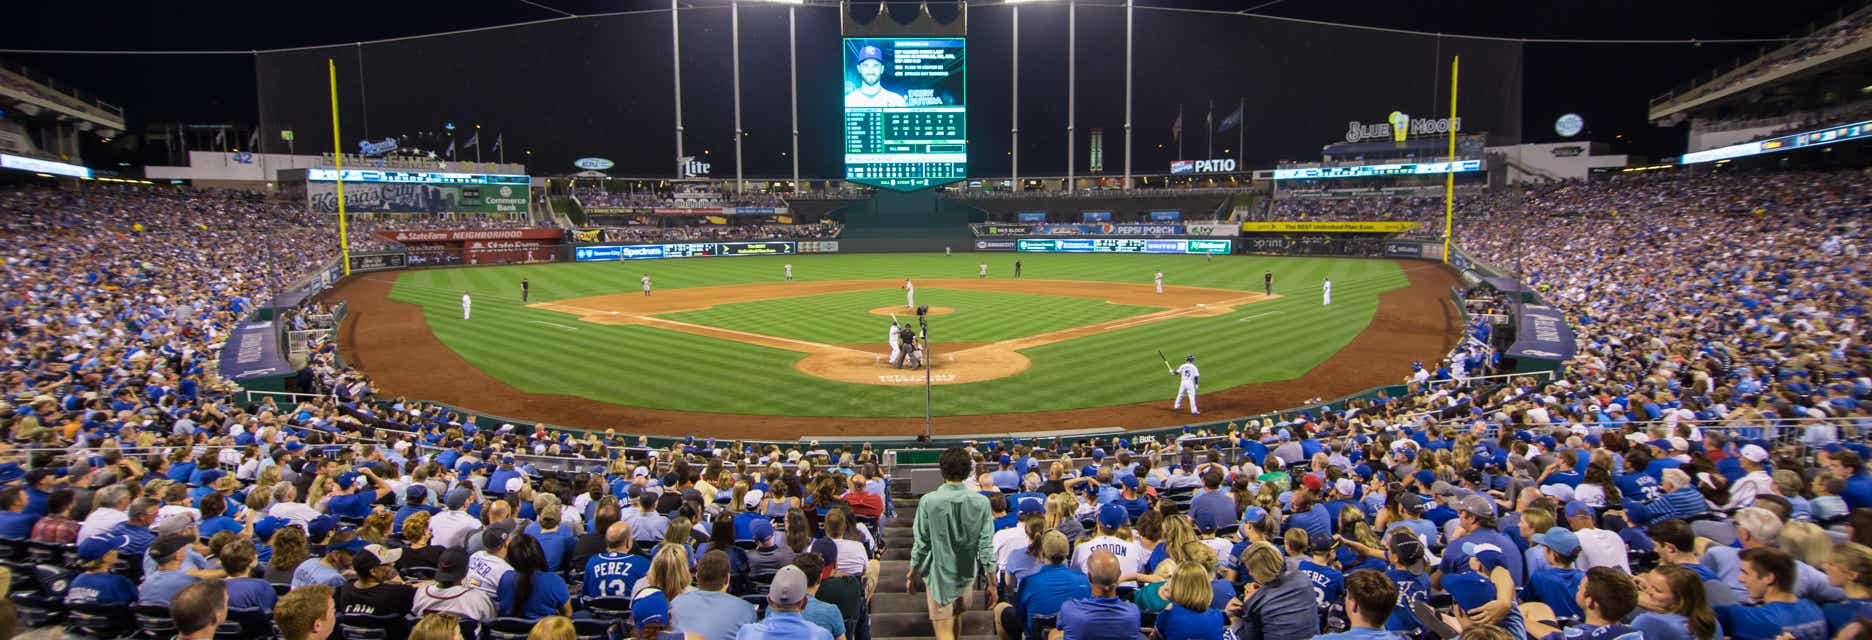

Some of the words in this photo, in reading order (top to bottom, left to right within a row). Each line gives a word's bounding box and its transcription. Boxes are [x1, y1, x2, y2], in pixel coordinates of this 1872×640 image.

[233, 152, 252, 164] 42
[684, 157, 710, 176] Lite
[1195, 159, 1235, 172] PATIO
[453, 231, 522, 239] NEIGHBORHOOD
[1118, 226, 1141, 234] PEPSI
[1143, 226, 1175, 235] PORCH
[623, 247, 661, 256] Spectrum
[594, 561, 633, 578] PEREZ
[1303, 570, 1331, 587] EREZ
[598, 579, 627, 597] 13
